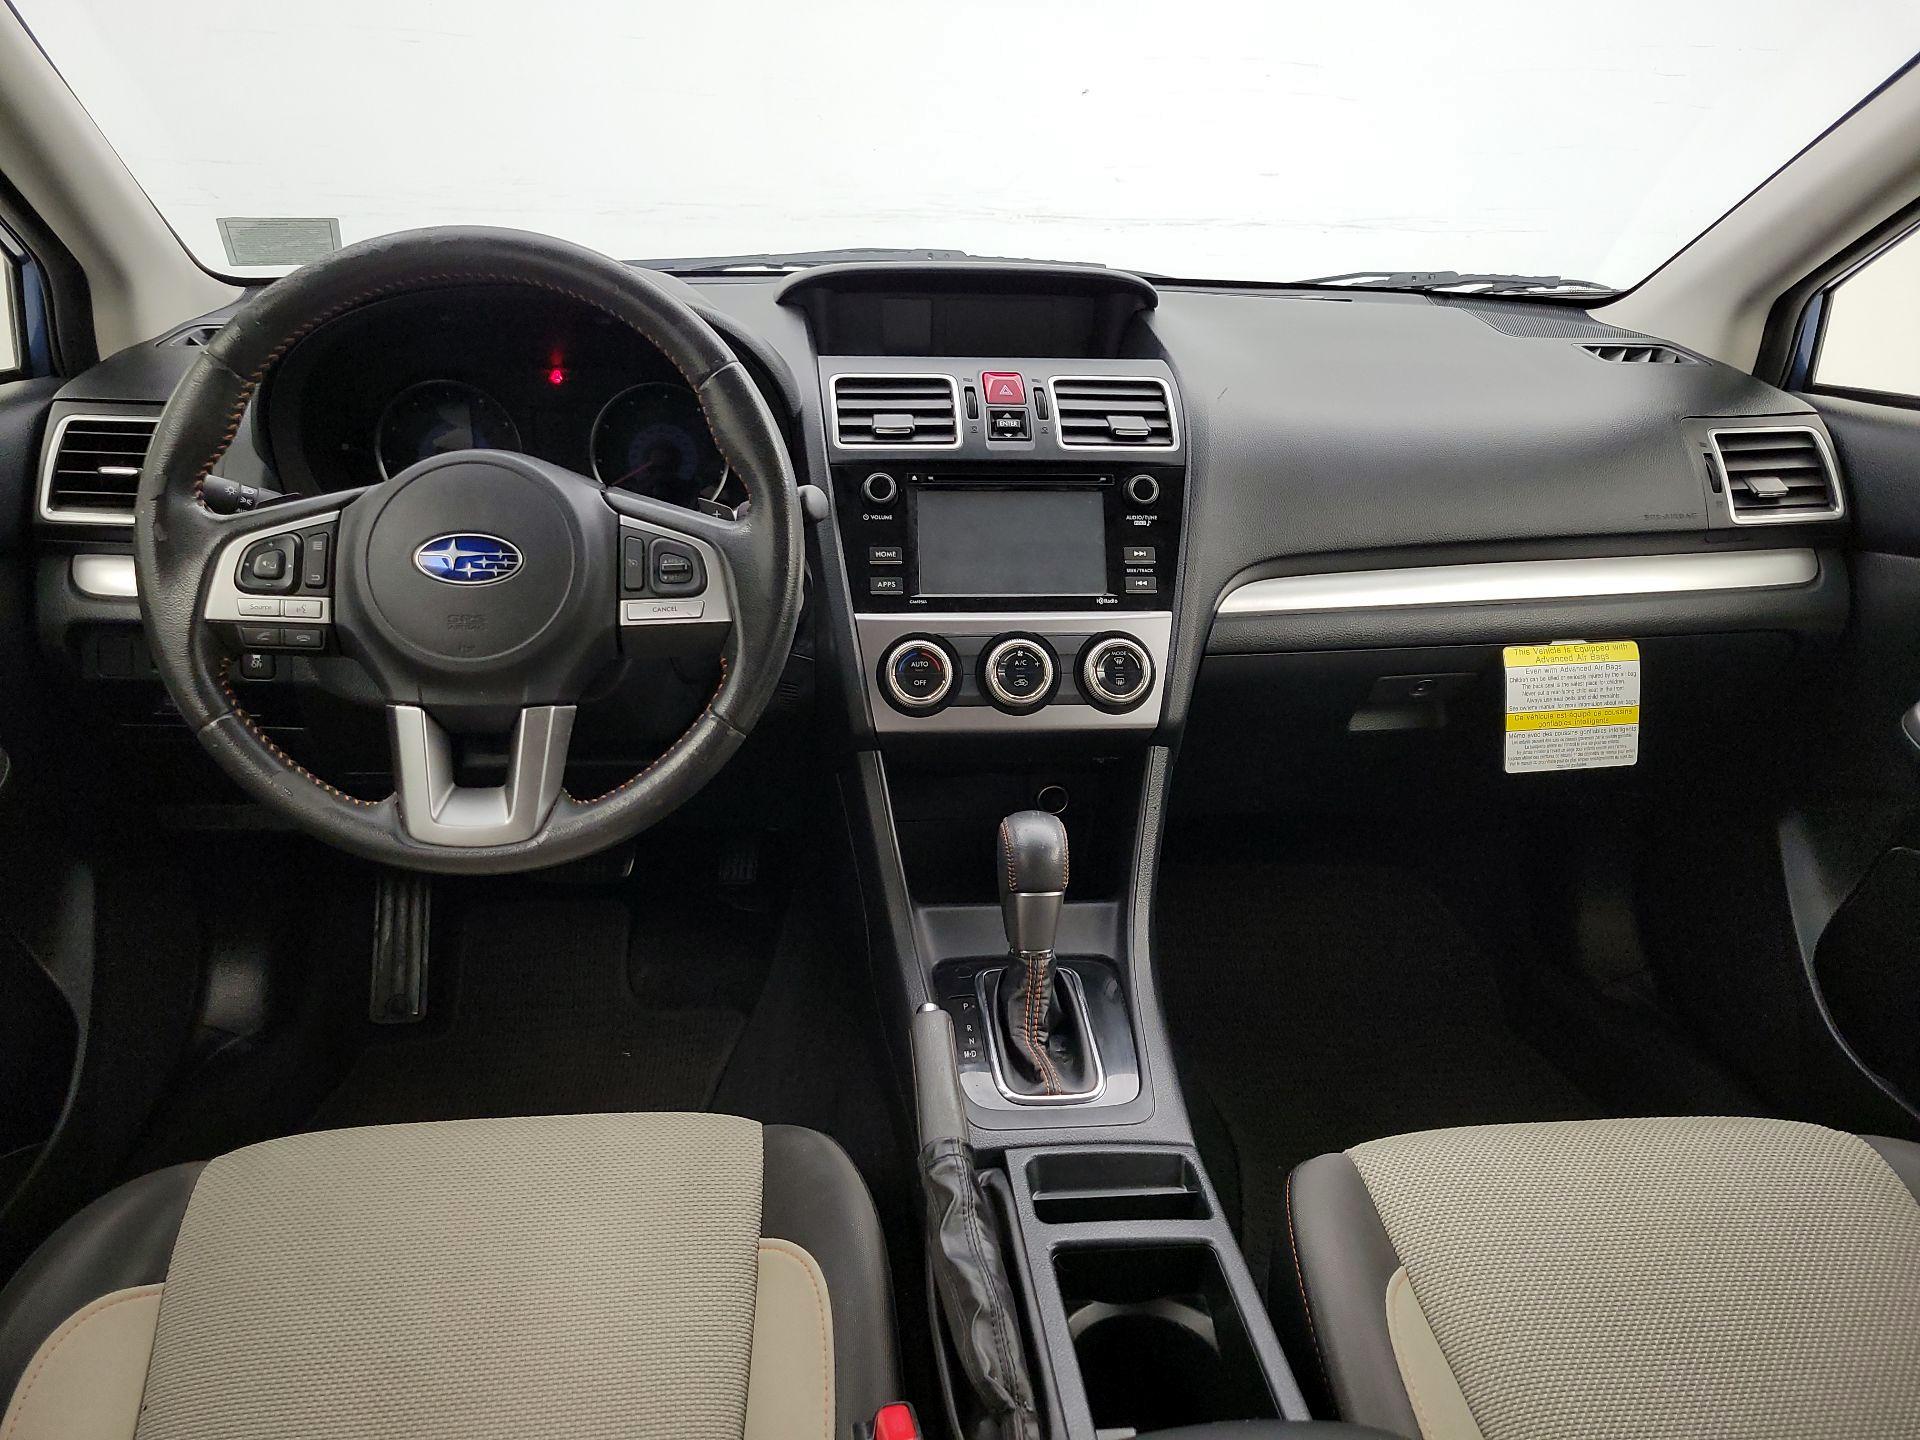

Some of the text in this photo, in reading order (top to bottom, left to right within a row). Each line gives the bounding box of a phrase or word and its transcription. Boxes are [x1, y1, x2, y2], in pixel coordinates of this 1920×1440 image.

[1514, 648, 1531, 656] This
[1533, 646, 1561, 655] Vehicle
[1573, 644, 1610, 653] Equipped
[1613, 642, 1628, 651] with
[1536, 653, 1610, 664] Advanced Air Bags
[911, 660, 929, 668] AUTO
[1014, 659, 1028, 667] A/C
[1560, 665, 1592, 673] Advanced
[1605, 663, 1622, 671] Bags
[913, 679, 927, 687] OFF
[962, 1003, 969, 1011] P
[966, 1024, 973, 1032] R
